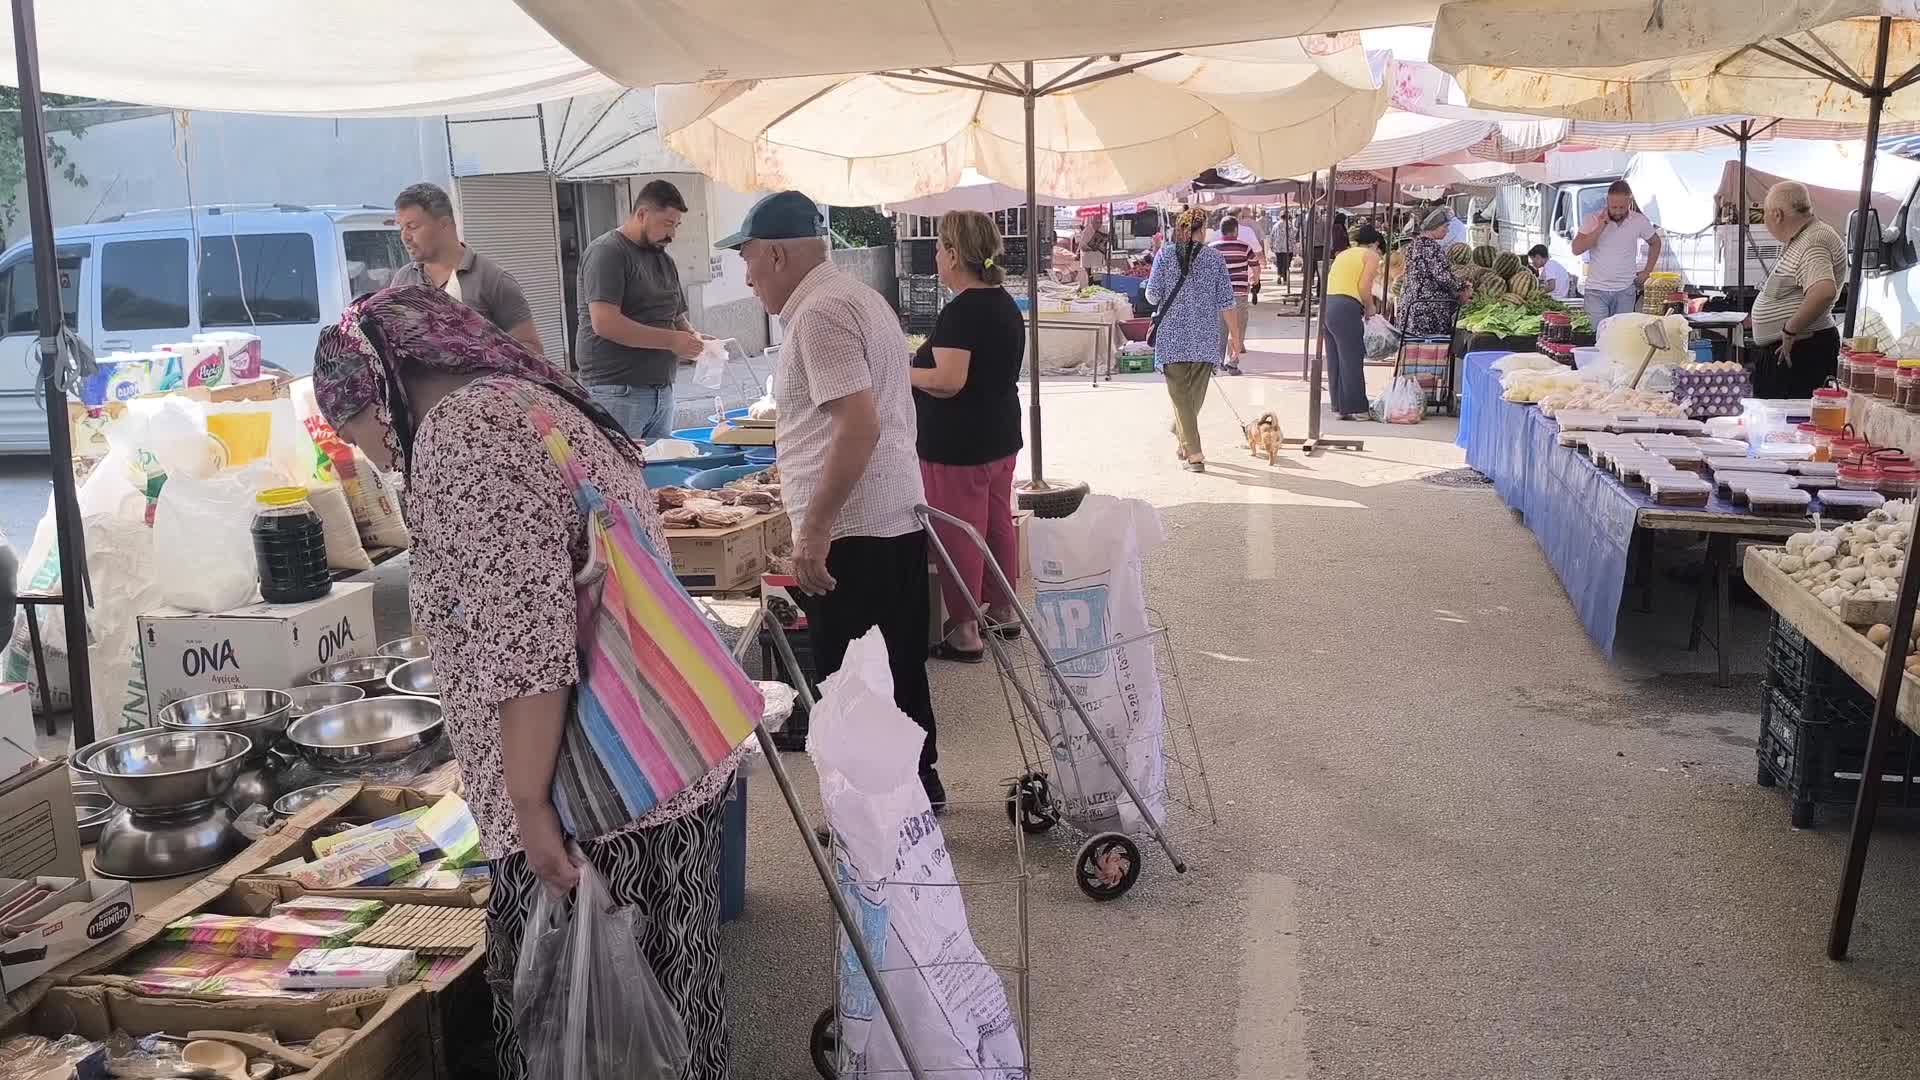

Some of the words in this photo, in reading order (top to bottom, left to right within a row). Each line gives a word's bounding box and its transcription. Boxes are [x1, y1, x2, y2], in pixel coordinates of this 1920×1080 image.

[183, 638, 240, 677] ONA
[318, 615, 354, 665] ONA
[89, 906, 129, 936] ÜZÜMOĞLU
